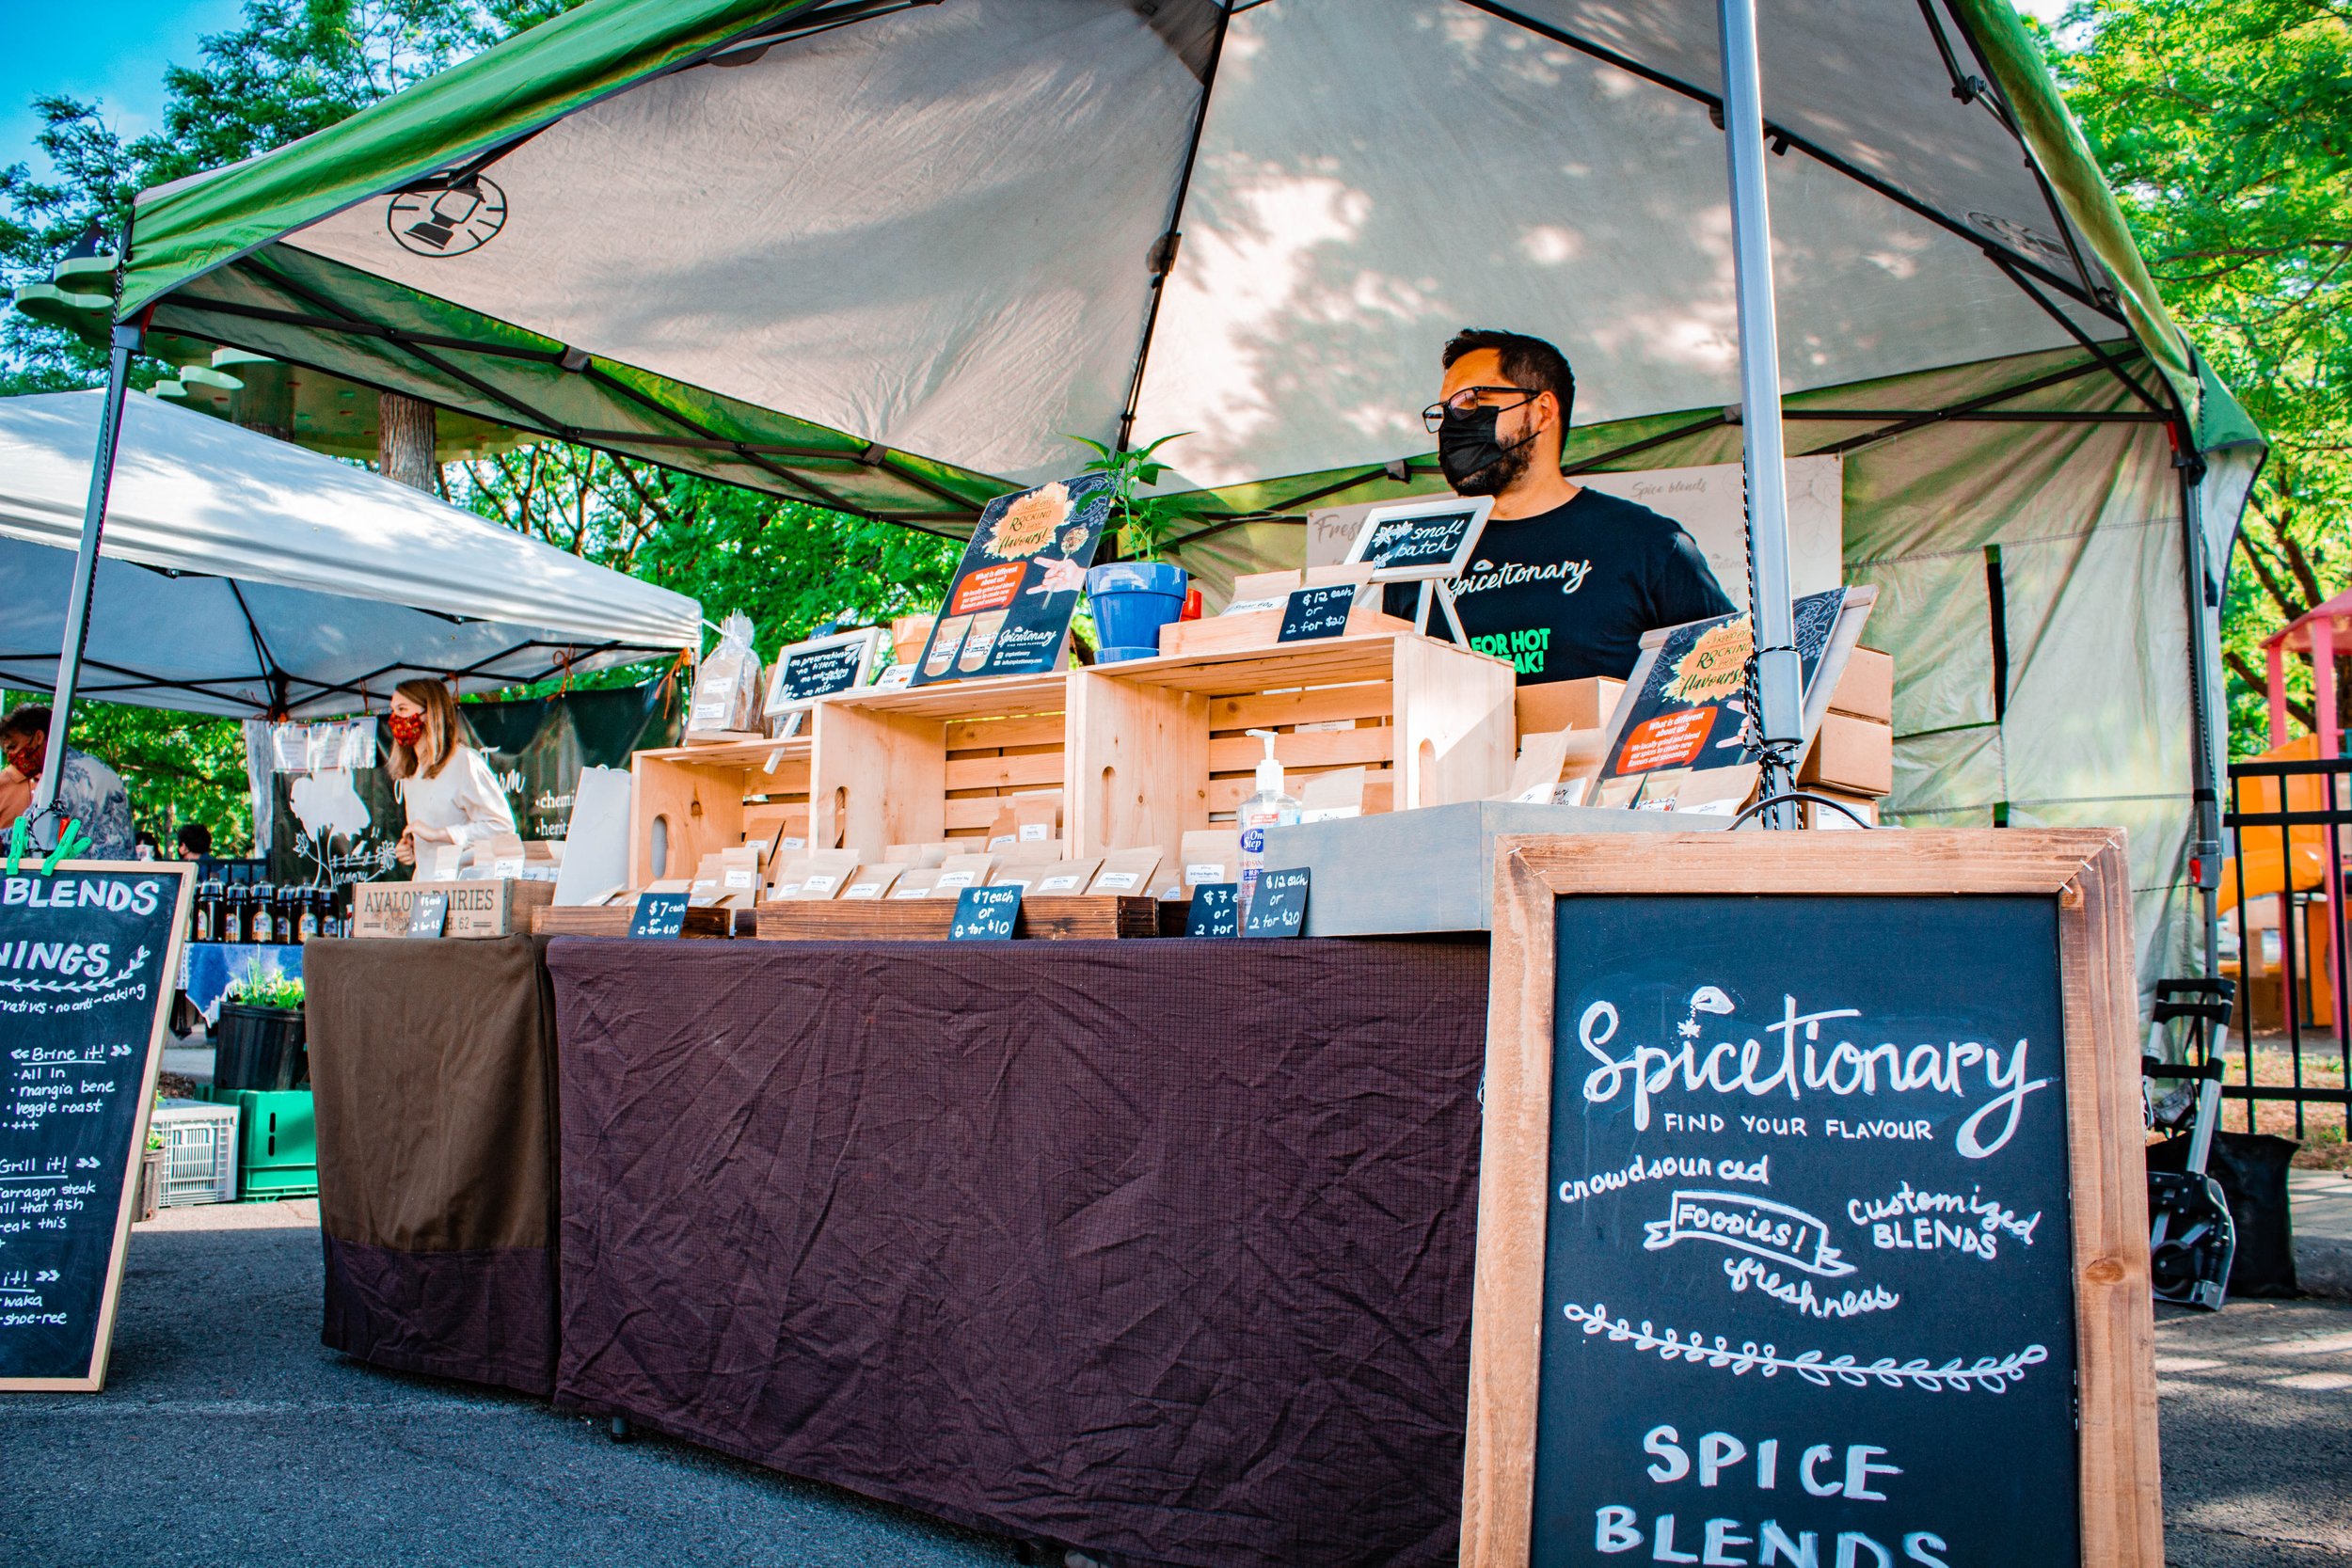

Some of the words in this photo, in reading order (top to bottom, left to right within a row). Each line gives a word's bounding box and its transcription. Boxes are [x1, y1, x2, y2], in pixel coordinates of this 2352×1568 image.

[1630, 481, 1663, 500] Spice
[1667, 478, 1708, 493] blends
[1411, 519, 1465, 540] small
[1394, 537, 1456, 559] batch
[976, 571, 989, 580] What
[994, 566, 1017, 576] different
[1302, 591, 1328, 607] $12
[1330, 587, 1354, 599] each
[1305, 607, 1323, 617] or
[1285, 623, 1297, 635] 2
[1300, 620, 1323, 632] for
[1325, 615, 1346, 627] $20
[997, 628, 1057, 648] Spicetionary
[1470, 633, 1510, 657] FOR
[1511, 627, 1551, 654] HOT
[1649, 720, 1668, 730] What
[1675, 712, 1704, 723] different
[1656, 727, 1676, 737] about
[1677, 723, 1690, 732] us?
[1658, 737, 1673, 747] grind
[1684, 730, 1701, 739] blend
[1641, 749, 1656, 758] spices
[1661, 749, 1690, 760] seasonings
[540, 789, 576, 809] chemi
[540, 816, 570, 837] herit
[1249, 830, 1265, 841] On
[1243, 836, 1262, 851] Step
[1265, 874, 1286, 890] $12
[1287, 873, 1309, 888] each
[2, 877, 160, 916] BLENDS
[364, 890, 424, 913] AVALO
[432, 889, 495, 912] AIRIES
[989, 889, 1014, 904] each
[1269, 894, 1284, 907] or
[668, 902, 687, 913] each
[977, 906, 995, 920] or
[1214, 909, 1231, 920] or
[458, 916, 469, 930] 62
[649, 917, 661, 927] or
[1248, 916, 1260, 930] 2
[1263, 913, 1280, 928] for
[1281, 908, 1300, 927] $20
[637, 926, 646, 936] 2
[646, 926, 662, 935] for
[662, 924, 679, 935] $10
[954, 924, 964, 939] 2
[967, 922, 986, 935] for
[987, 918, 1010, 935] $10
[1194, 923, 1205, 936] 2
[1212, 924, 1234, 936] for
[55, 1003, 71, 1014] no
[31, 1047, 77, 1062] Brine
[84, 1043, 104, 1059] it!
[21, 1067, 42, 1081] All
[50, 1067, 66, 1079] In
[1578, 993, 2051, 1160] Spicetionary
[19, 1084, 73, 1101] mangia
[80, 1079, 116, 1094] bene
[61, 1098, 103, 1114] roast
[1663, 1111, 1725, 1133] FIND
[1739, 1114, 1808, 1138] YOUR
[1824, 1118, 1934, 1142] FLAVOUR
[46, 1155, 68, 1173] it!
[61, 1180, 96, 1196] steak
[20, 1199, 49, 1214] that
[53, 1196, 84, 1212] fish
[38, 1215, 68, 1229] this
[1677, 1203, 1807, 1254] Foodies!
[1871, 1222, 1998, 1261] BLENDS
[3, 1269, 28, 1289] it!
[1723, 1256, 1900, 1319] freshness
[1642, 1424, 1904, 1501] SPICE
[1595, 1505, 1950, 1568] BLENDS
